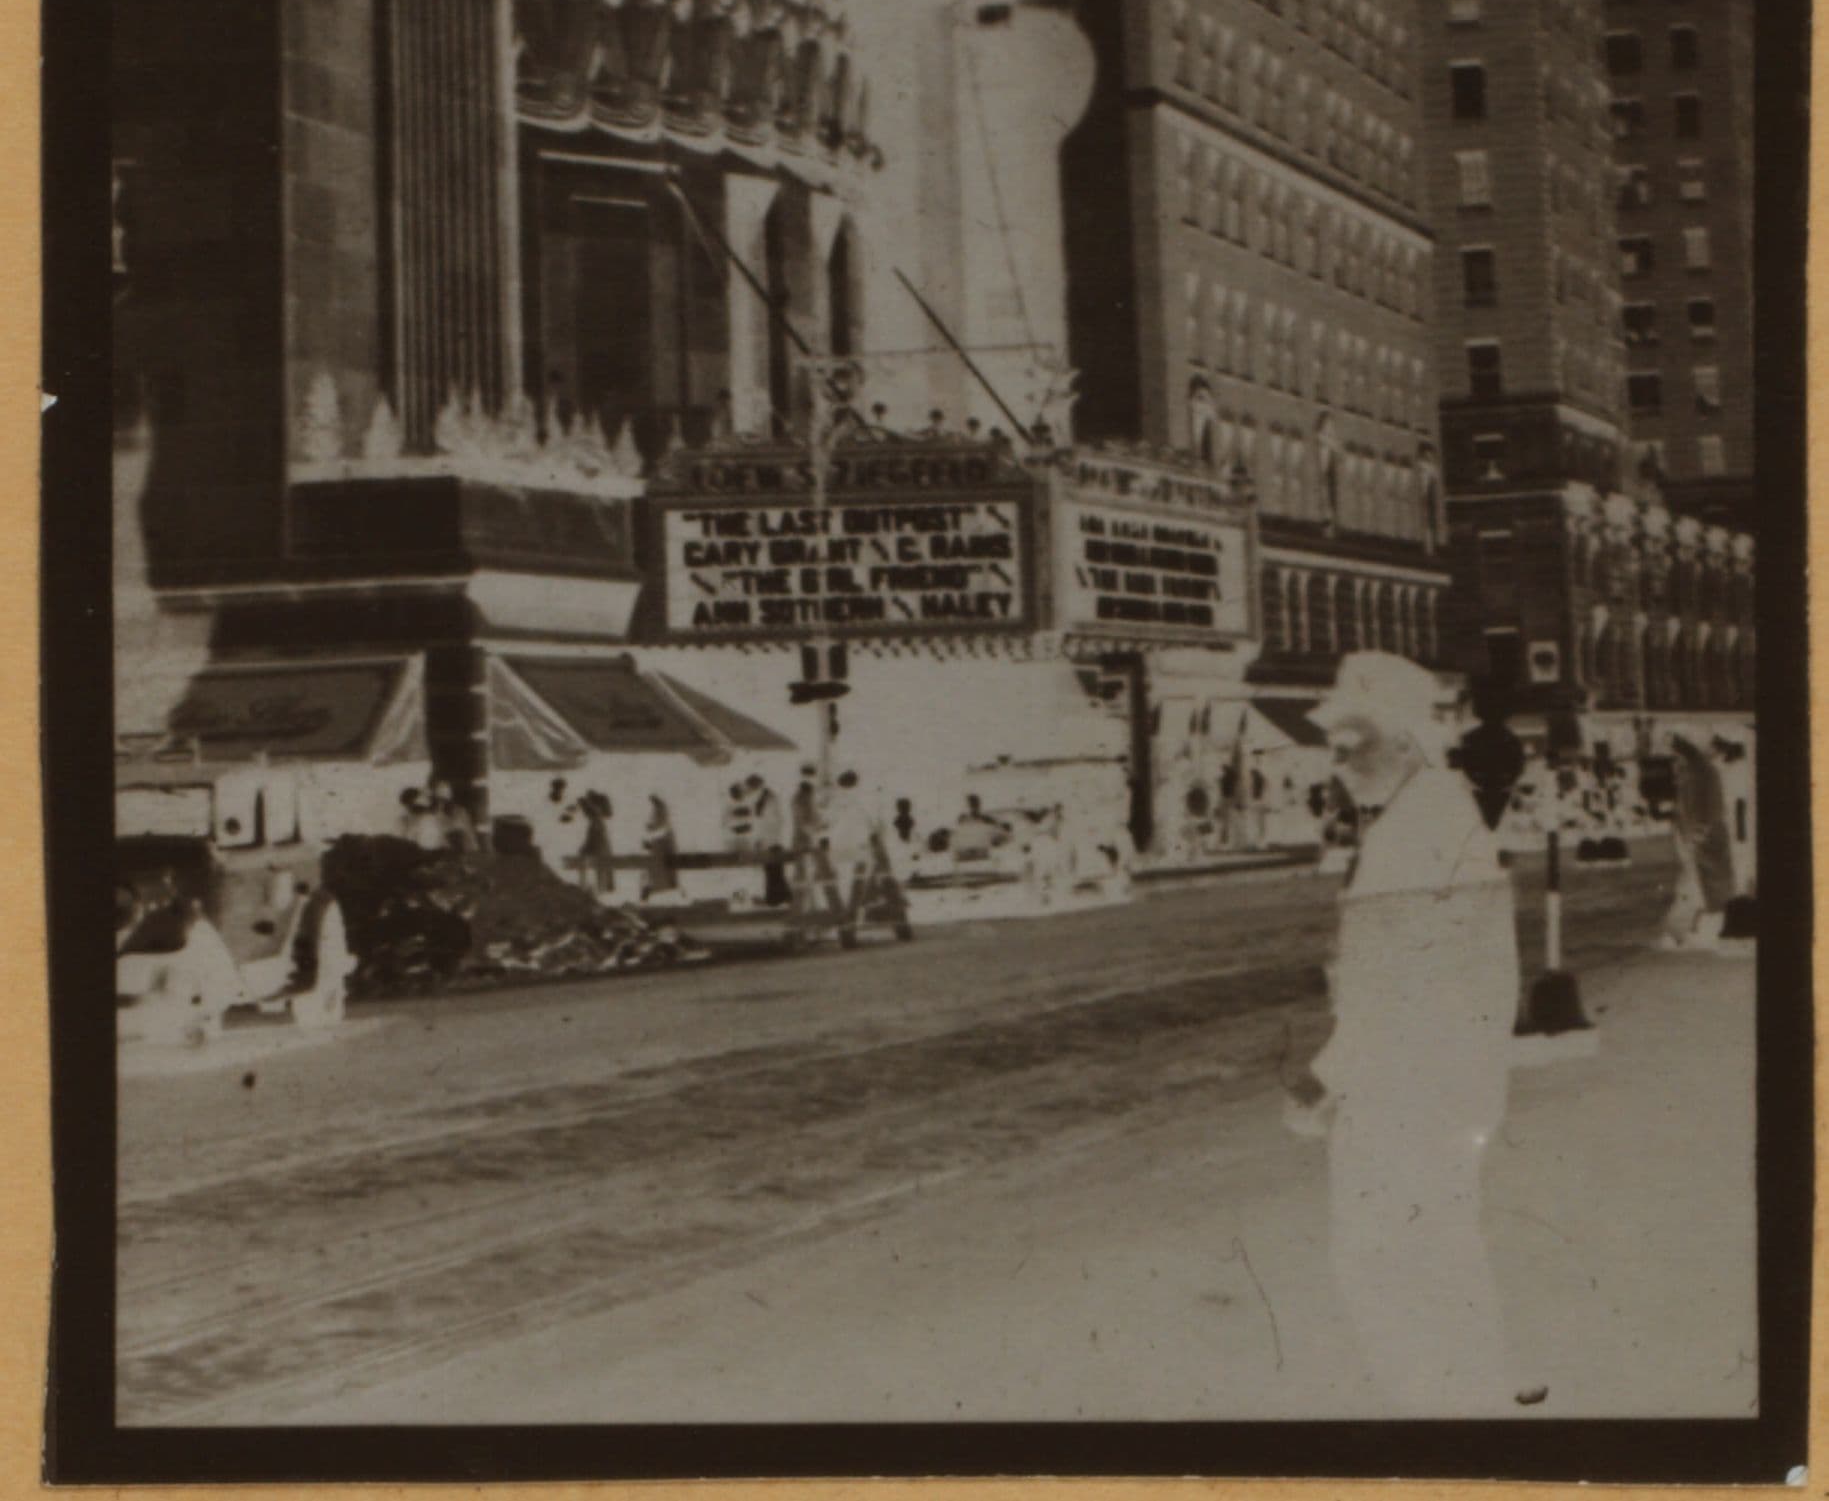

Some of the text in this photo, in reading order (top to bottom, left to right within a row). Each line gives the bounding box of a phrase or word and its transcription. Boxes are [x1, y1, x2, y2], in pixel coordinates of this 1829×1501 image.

[758, 508, 832, 538] LAST
[683, 539, 761, 568] CARY
[768, 537, 863, 568] GRANT
[929, 533, 1014, 563] RAINS
[800, 566, 865, 595] GRL
[692, 599, 752, 626] ANN
[918, 591, 1013, 621] HALEY
